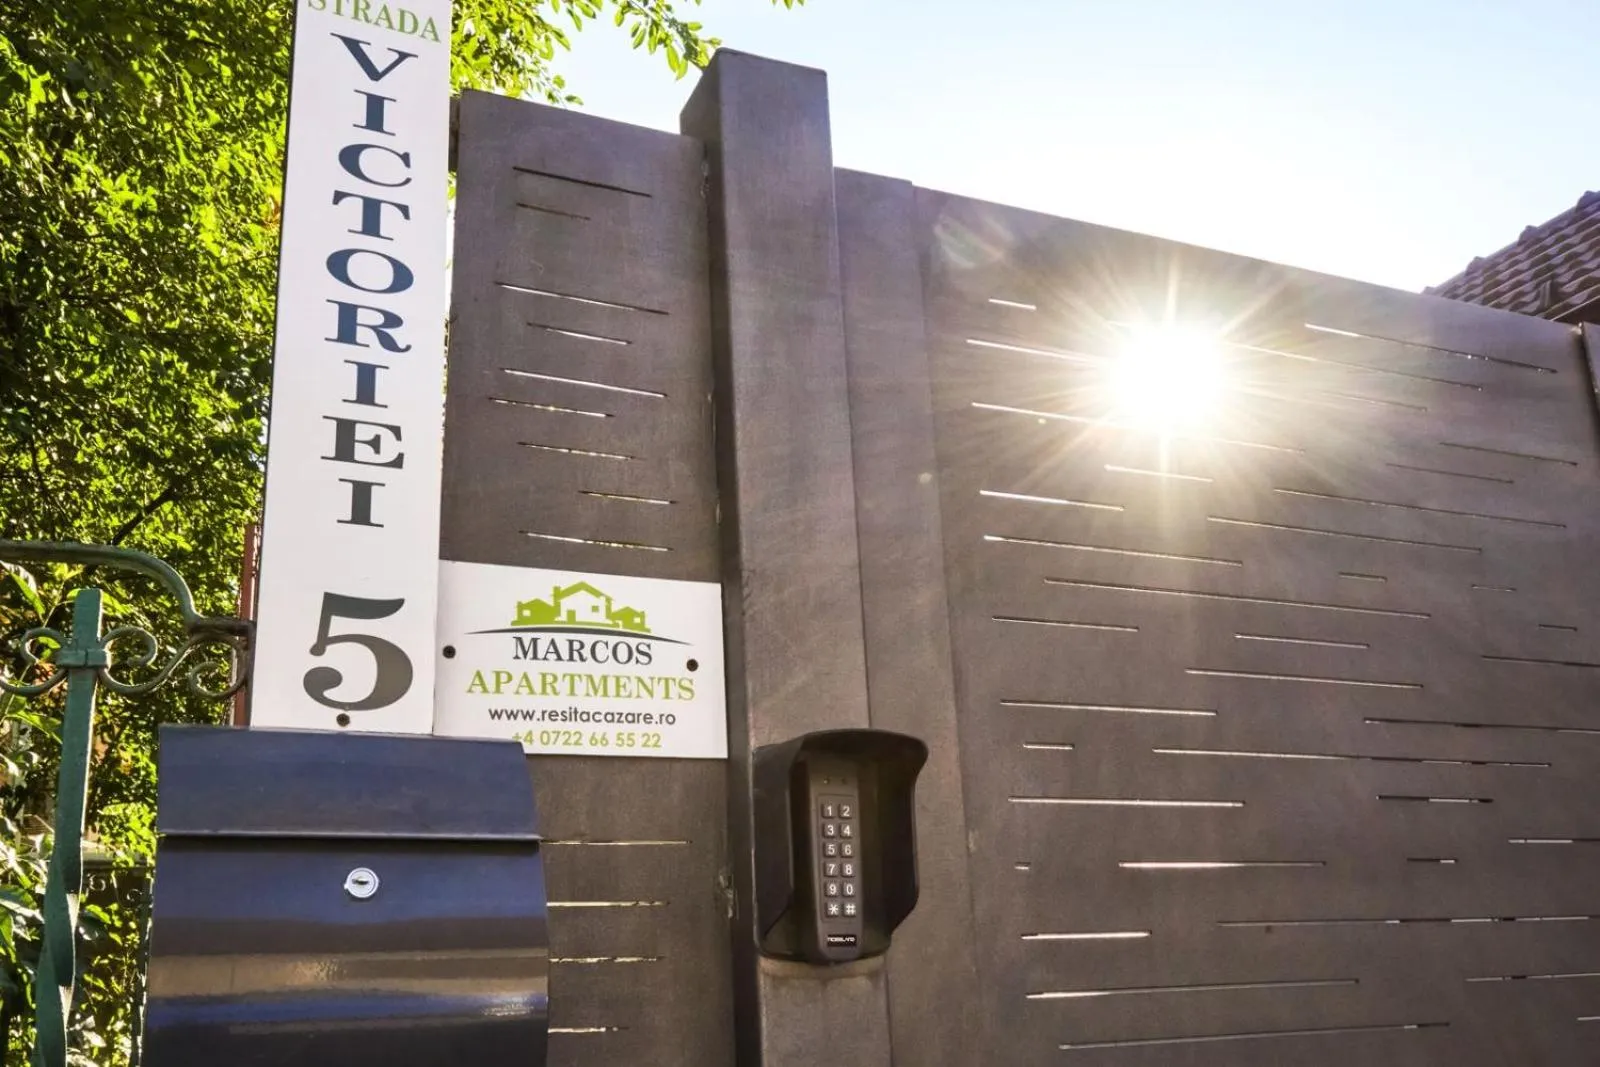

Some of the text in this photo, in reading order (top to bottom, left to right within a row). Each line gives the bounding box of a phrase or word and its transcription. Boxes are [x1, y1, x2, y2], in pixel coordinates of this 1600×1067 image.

[303, 32, 419, 711] VICTORIEI 5
[512, 636, 653, 666] MARCOS
[466, 669, 696, 701] APARTMENTS
[488, 706, 677, 726] www.resitacazare.ro
[539, 730, 583, 746] 0722
[589, 731, 609, 747] 66
[615, 732, 636, 748] 55
[641, 733, 662, 748] 22
